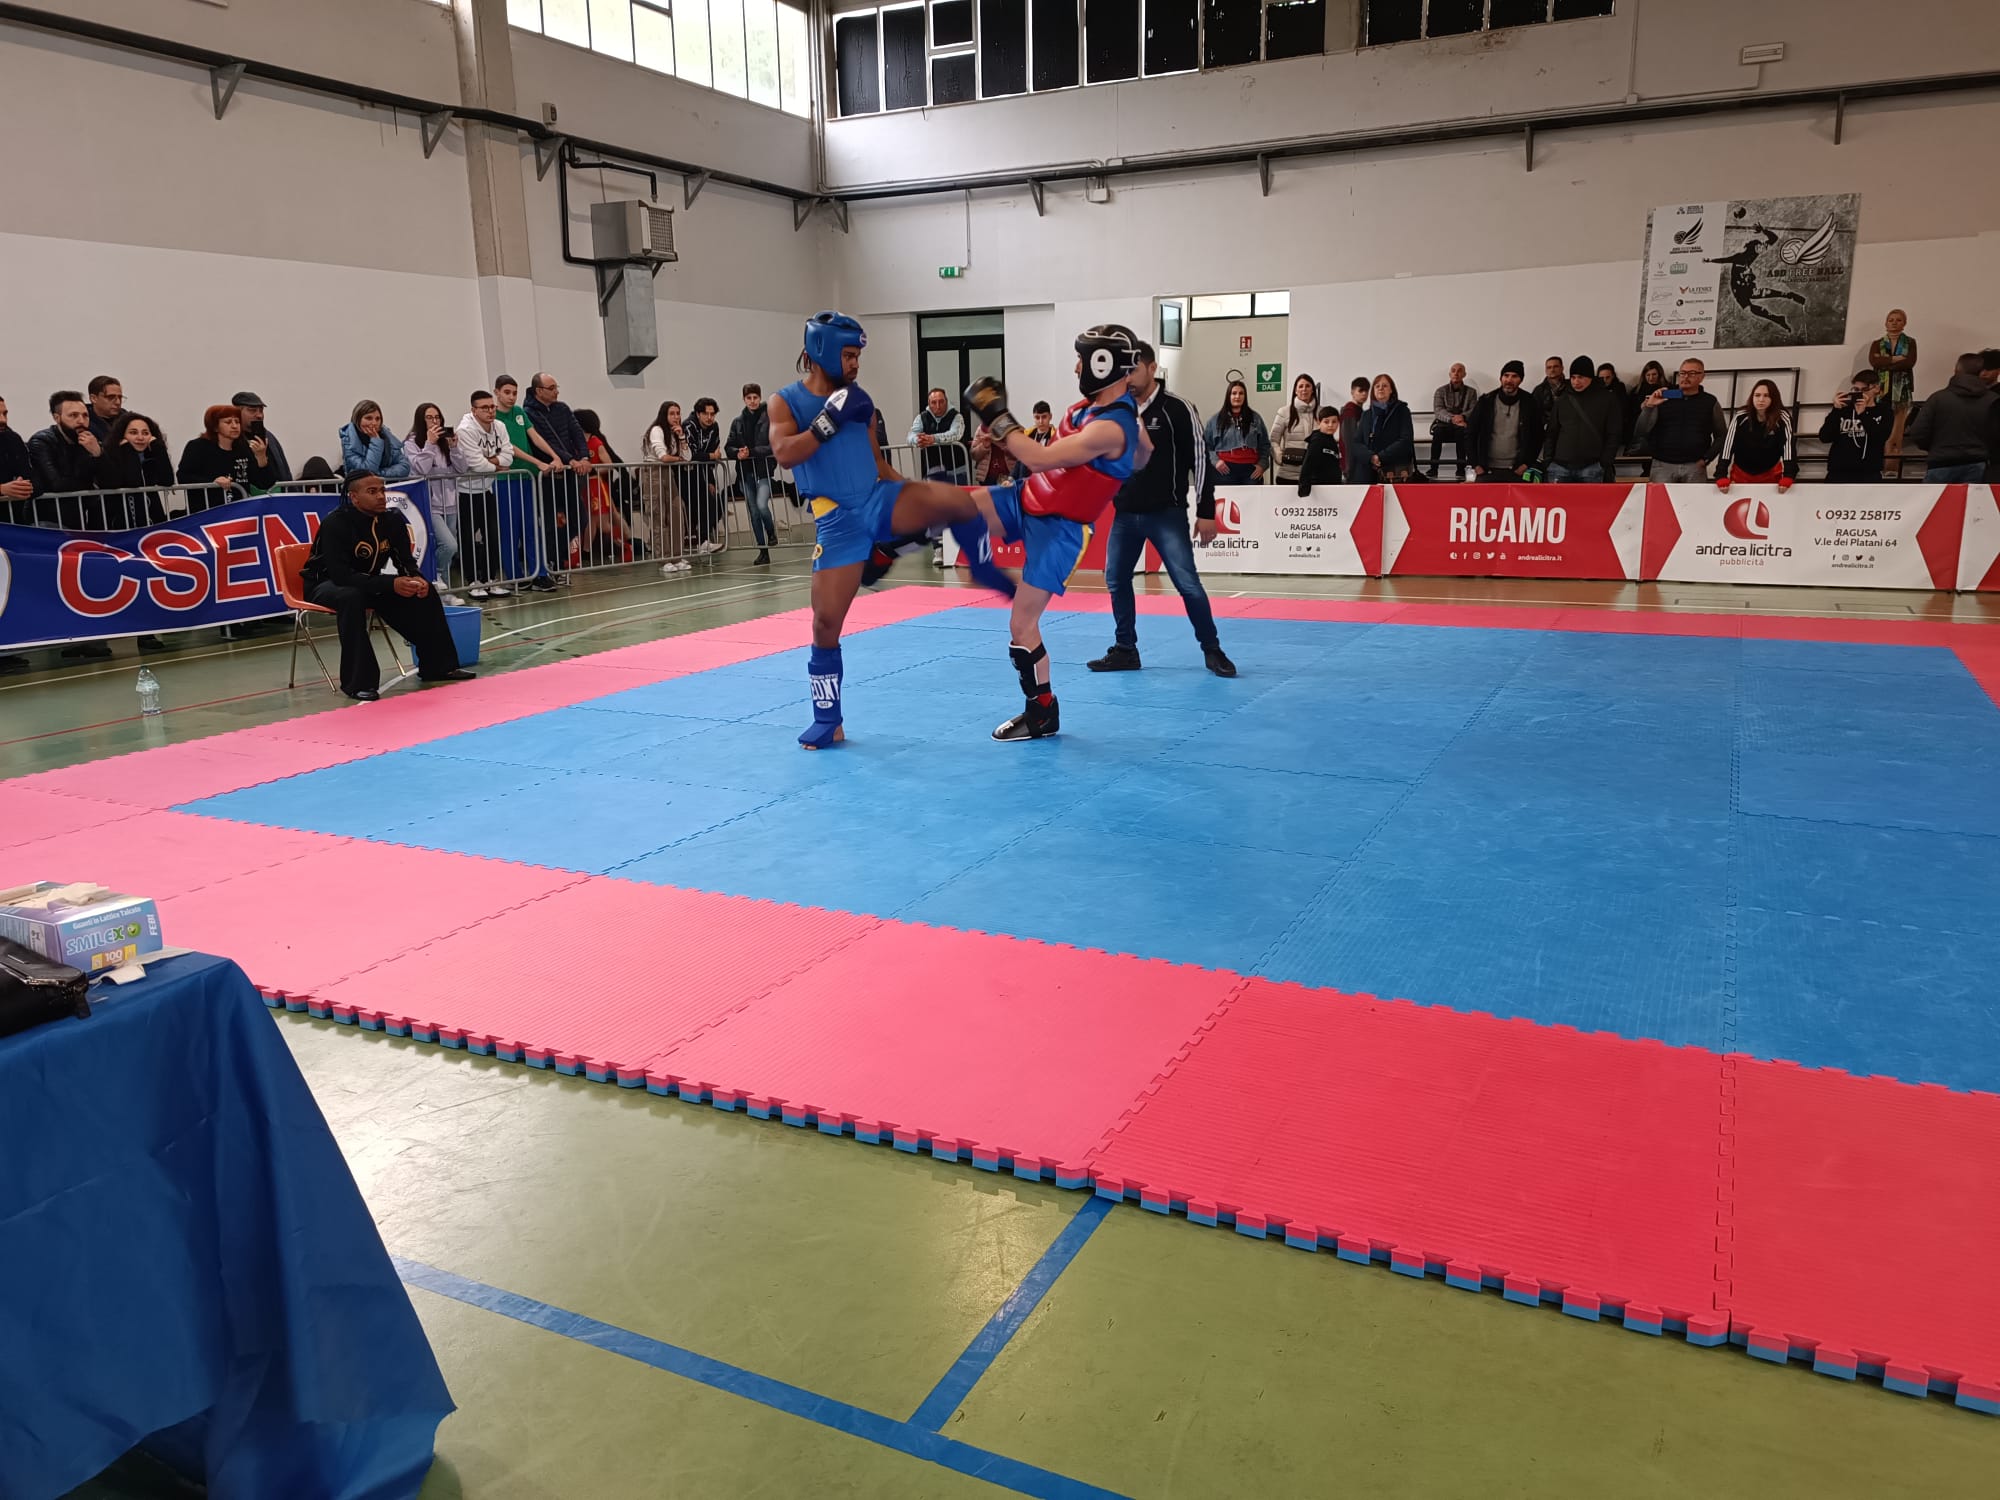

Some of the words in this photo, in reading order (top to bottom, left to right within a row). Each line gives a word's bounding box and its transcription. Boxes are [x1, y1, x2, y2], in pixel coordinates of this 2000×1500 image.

[1789, 268, 1815, 276] FREE
[1282, 507, 1305, 517] 0932
[1307, 507, 1338, 517] 258175
[1825, 510, 1857, 520] 0932
[1859, 510, 1902, 521] 258175
[1290, 523, 1322, 531] RAGUSA
[1449, 506, 1567, 544] RICAMO
[1274, 531, 1288, 539] V.le
[1301, 531, 1326, 540] Platani
[1327, 532, 1337, 540] 64
[1835, 528, 1878, 537] RAGUSA
[1227, 537, 1259, 549] licitra
[1814, 537, 1832, 546] V.le
[1833, 538, 1848, 546] dei
[1850, 538, 1883, 547] Platani
[1885, 539, 1898, 547] 64
[1695, 542, 1747, 556] andrea
[1749, 543, 1792, 557] licitra
[1719, 558, 1765, 566] pubblicità
[66, 925, 125, 956] SMILEX
